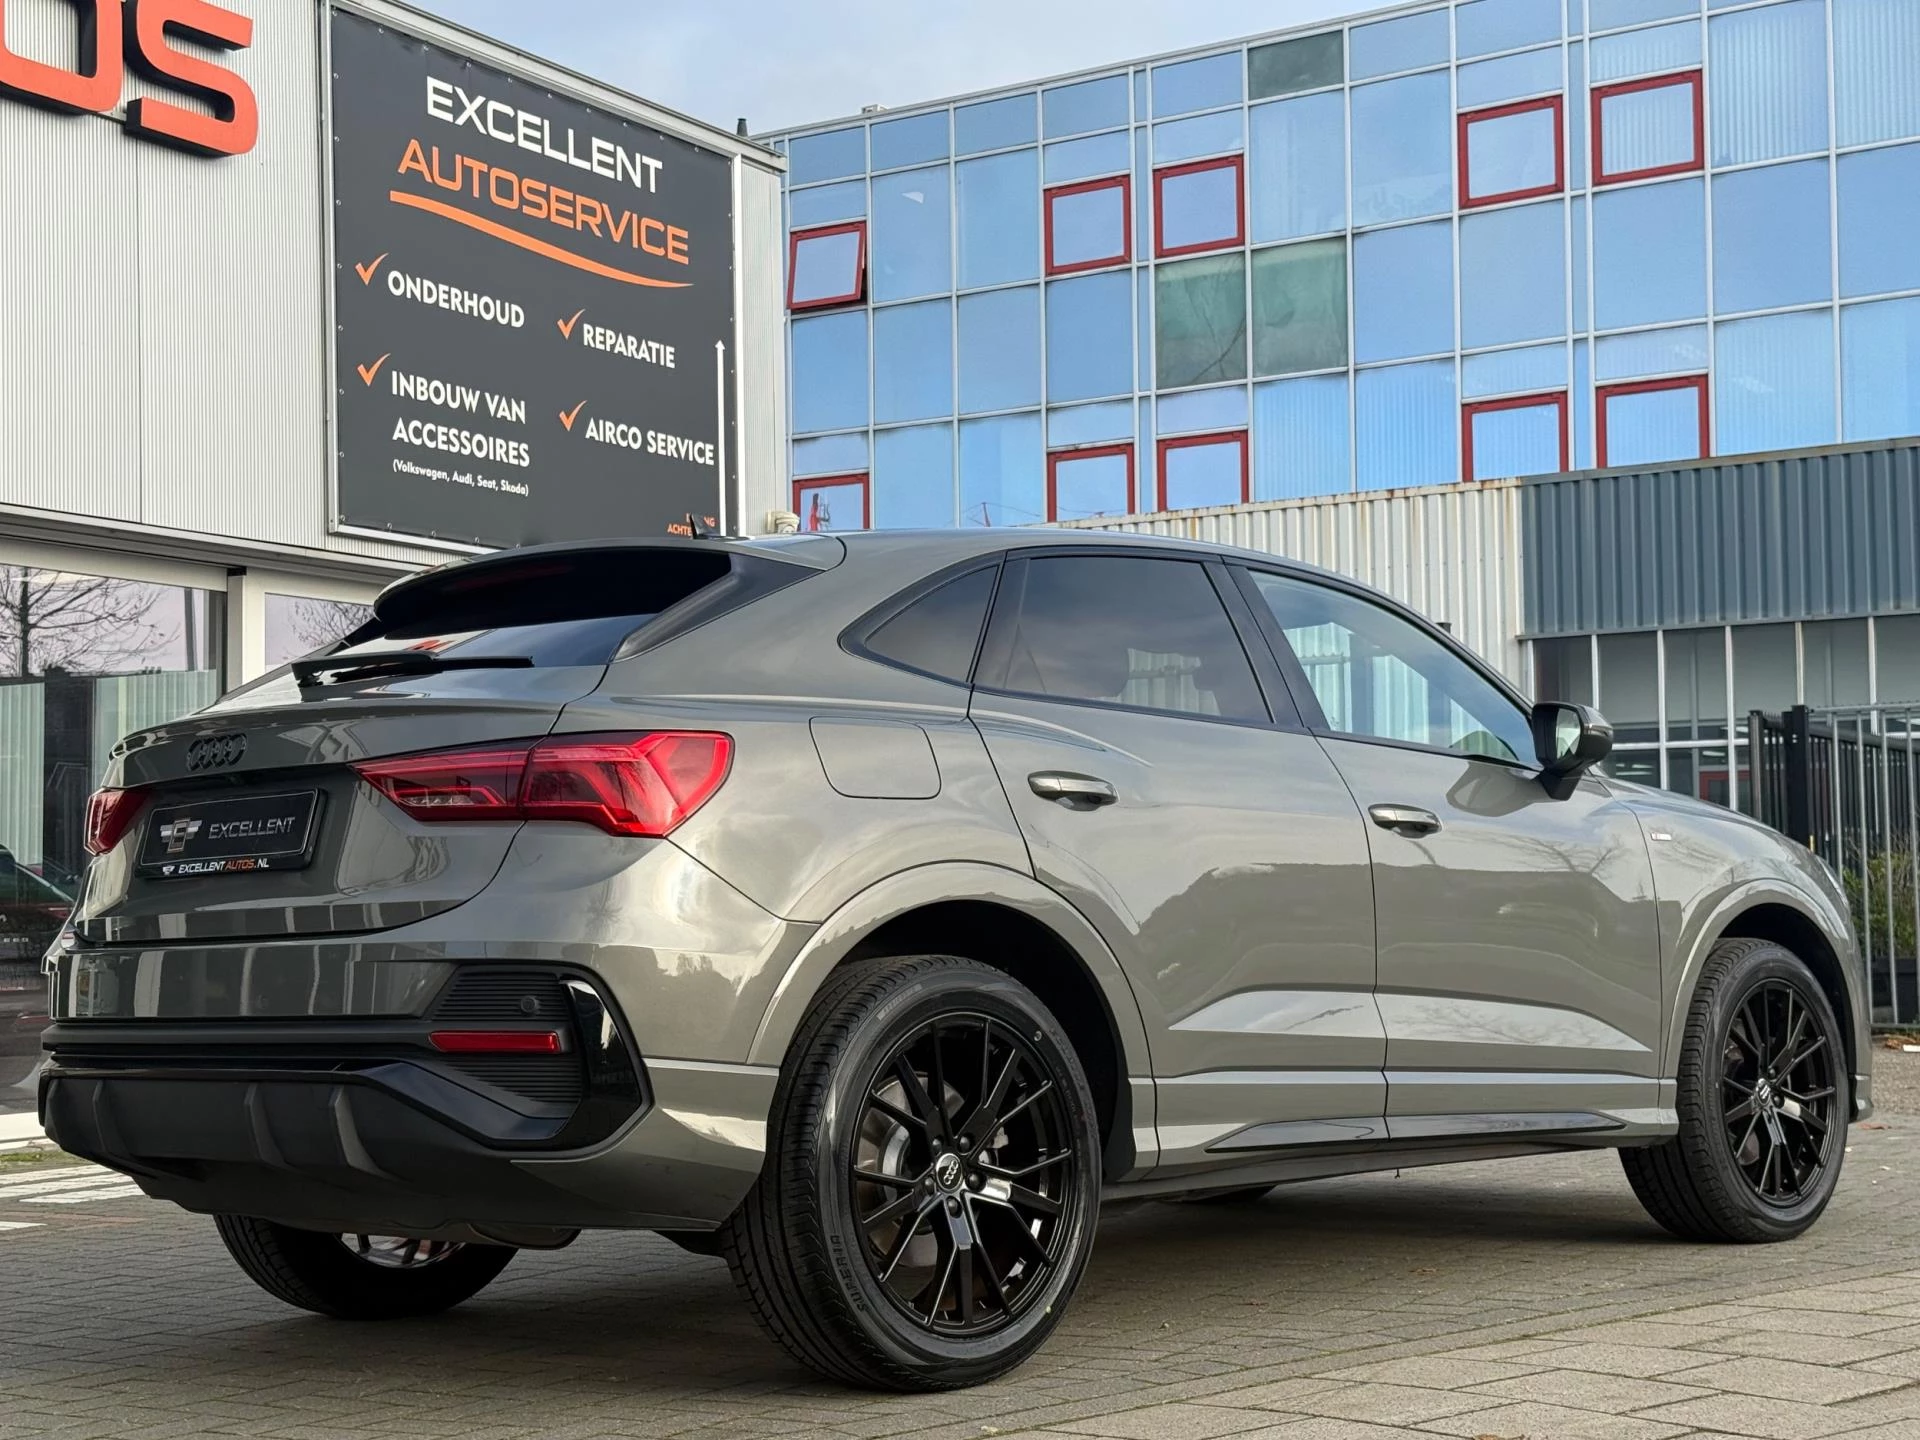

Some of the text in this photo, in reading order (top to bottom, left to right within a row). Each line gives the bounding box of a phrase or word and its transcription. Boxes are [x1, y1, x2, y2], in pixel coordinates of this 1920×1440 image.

[426, 76, 663, 193] EXCELLENT
[398, 139, 689, 265] AUTOSERVICE
[387, 270, 525, 328] ONDERHOUD
[583, 323, 676, 369] REPARATIE
[391, 370, 526, 425] INBOUW VAN
[392, 417, 531, 468] ACCESSOIRES
[585, 417, 715, 466] AIRCO SERVICE
[392, 458, 529, 497] (Volkswagen, Audi, Seat, Skoda)
[208, 817, 296, 839] EXCELLENT
